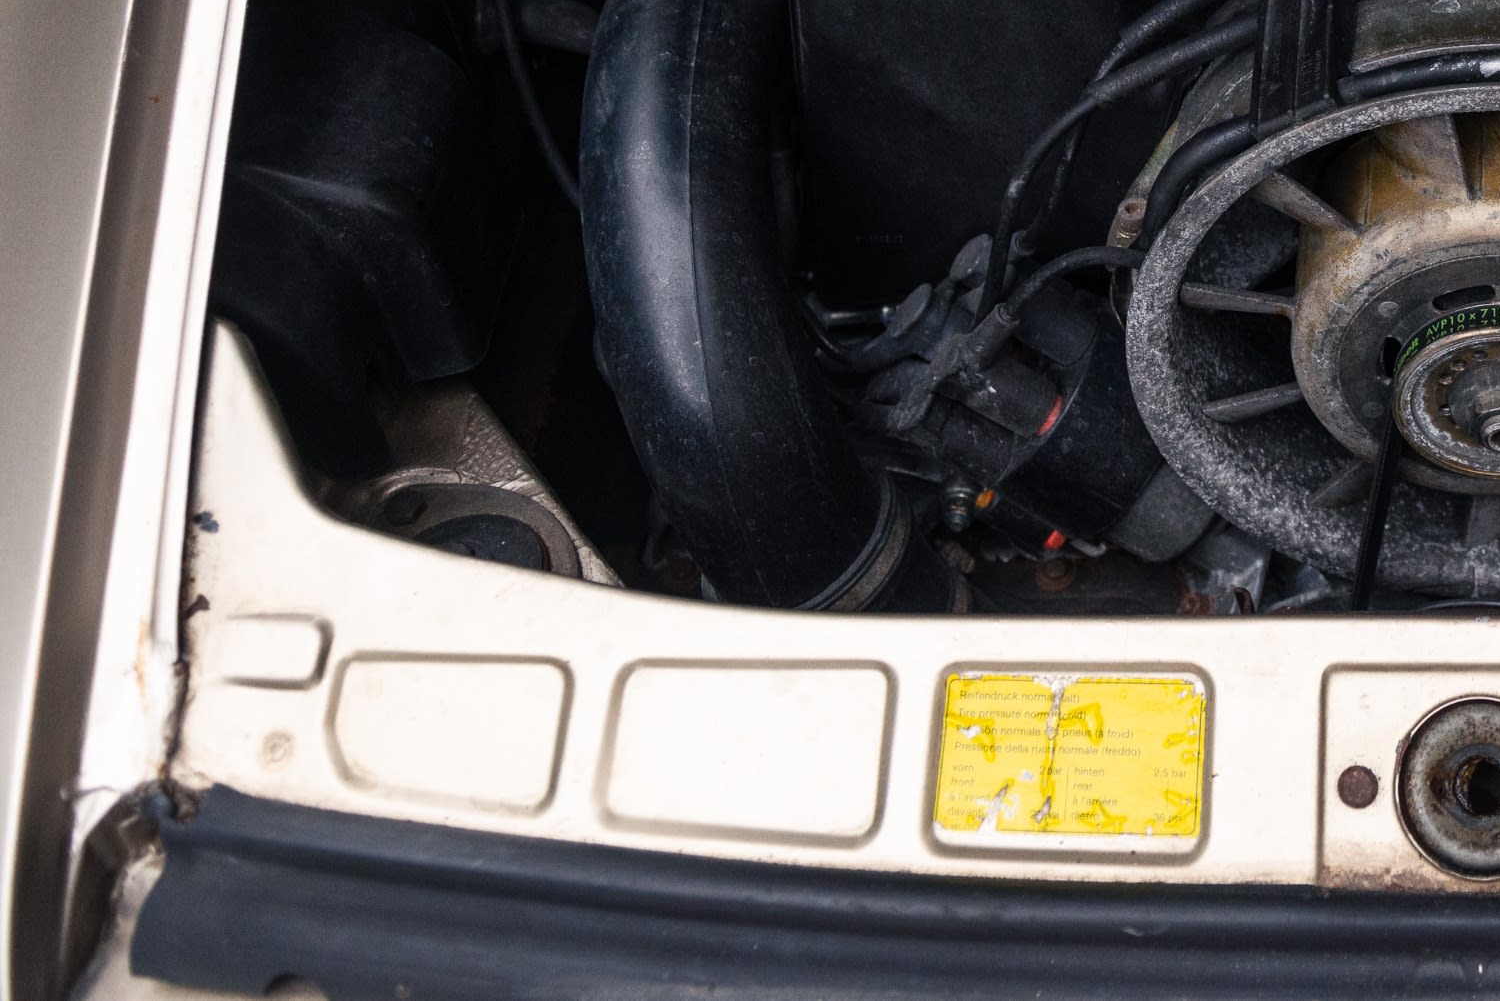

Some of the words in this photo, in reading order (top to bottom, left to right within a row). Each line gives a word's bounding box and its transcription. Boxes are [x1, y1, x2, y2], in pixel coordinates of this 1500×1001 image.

[1424, 311, 1465, 338] AVP10
[960, 690, 1018, 701] Reifendruck
[979, 709, 1022, 720] pressure
[1000, 727, 1041, 737] normale
[954, 742, 1002, 752] Pressione
[1005, 743, 1029, 753] della
[1058, 746, 1098, 756] normale
[951, 764, 975, 772] vorn
[1074, 767, 1105, 777] hinten
[1171, 768, 1187, 778] bar
[1073, 782, 1093, 791] rear
